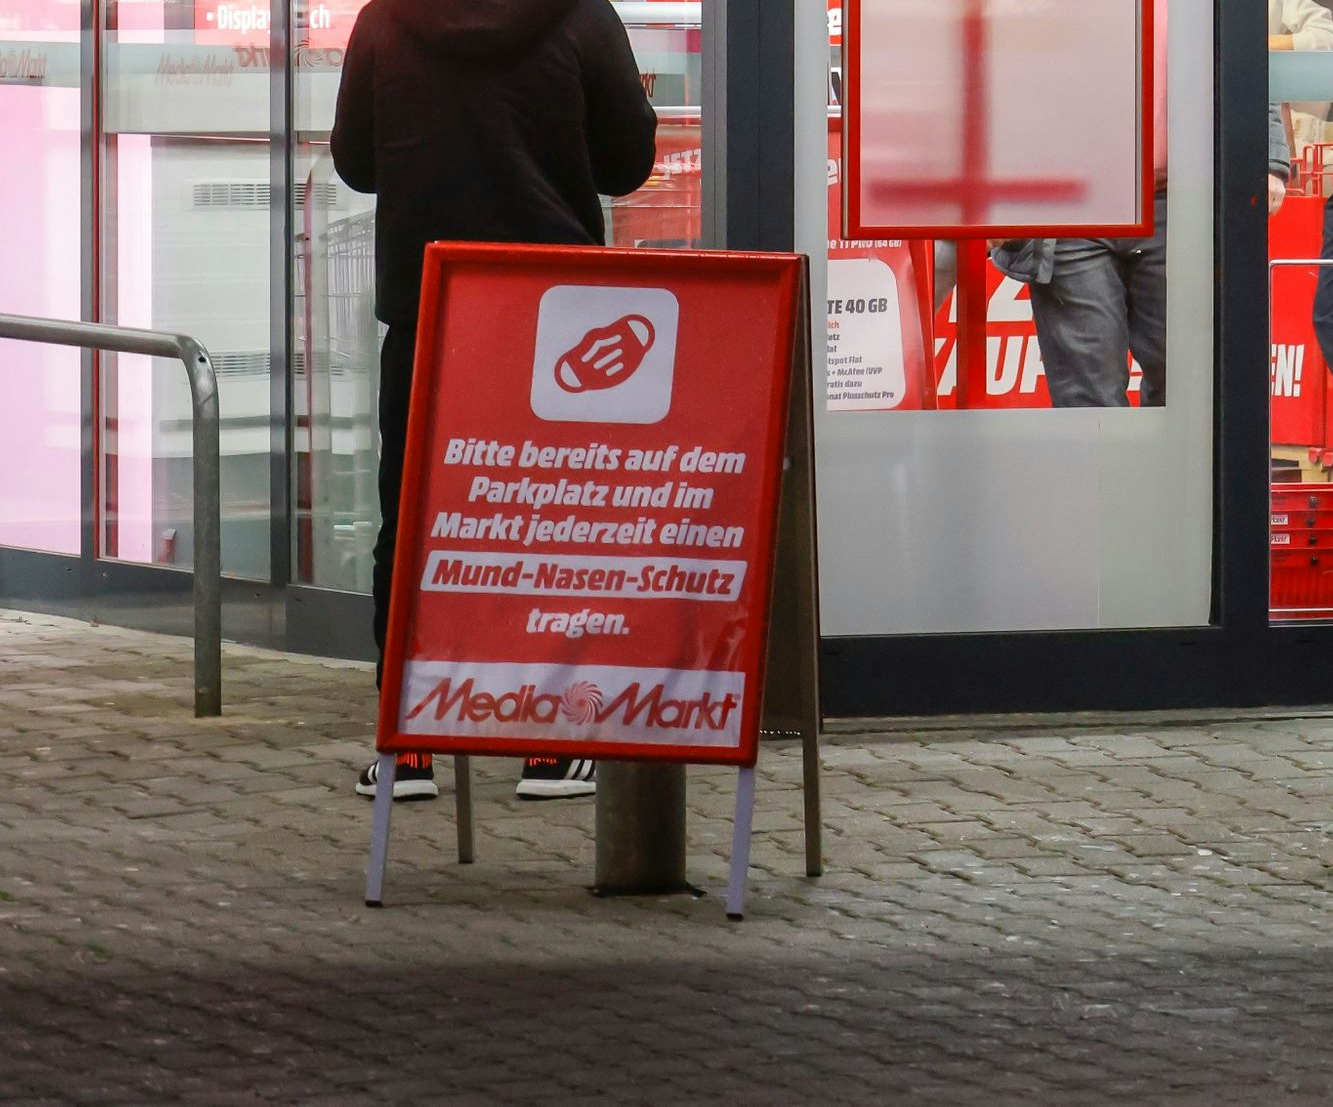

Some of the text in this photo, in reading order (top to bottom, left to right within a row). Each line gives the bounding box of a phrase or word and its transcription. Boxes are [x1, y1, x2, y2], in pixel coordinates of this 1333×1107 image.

[845, 297, 865, 315] 40
[868, 297, 888, 314] GB
[837, 367, 865, 376] McAfee
[845, 379, 862, 388] dazu
[443, 438, 746, 475] Bitte bereits auf dem
[467, 476, 714, 510] Parkplatz und im
[430, 511, 745, 549] Markt jederzeit einen
[431, 558, 735, 595] Mund-Nasen-Schutz
[526, 607, 631, 639] tragen.
